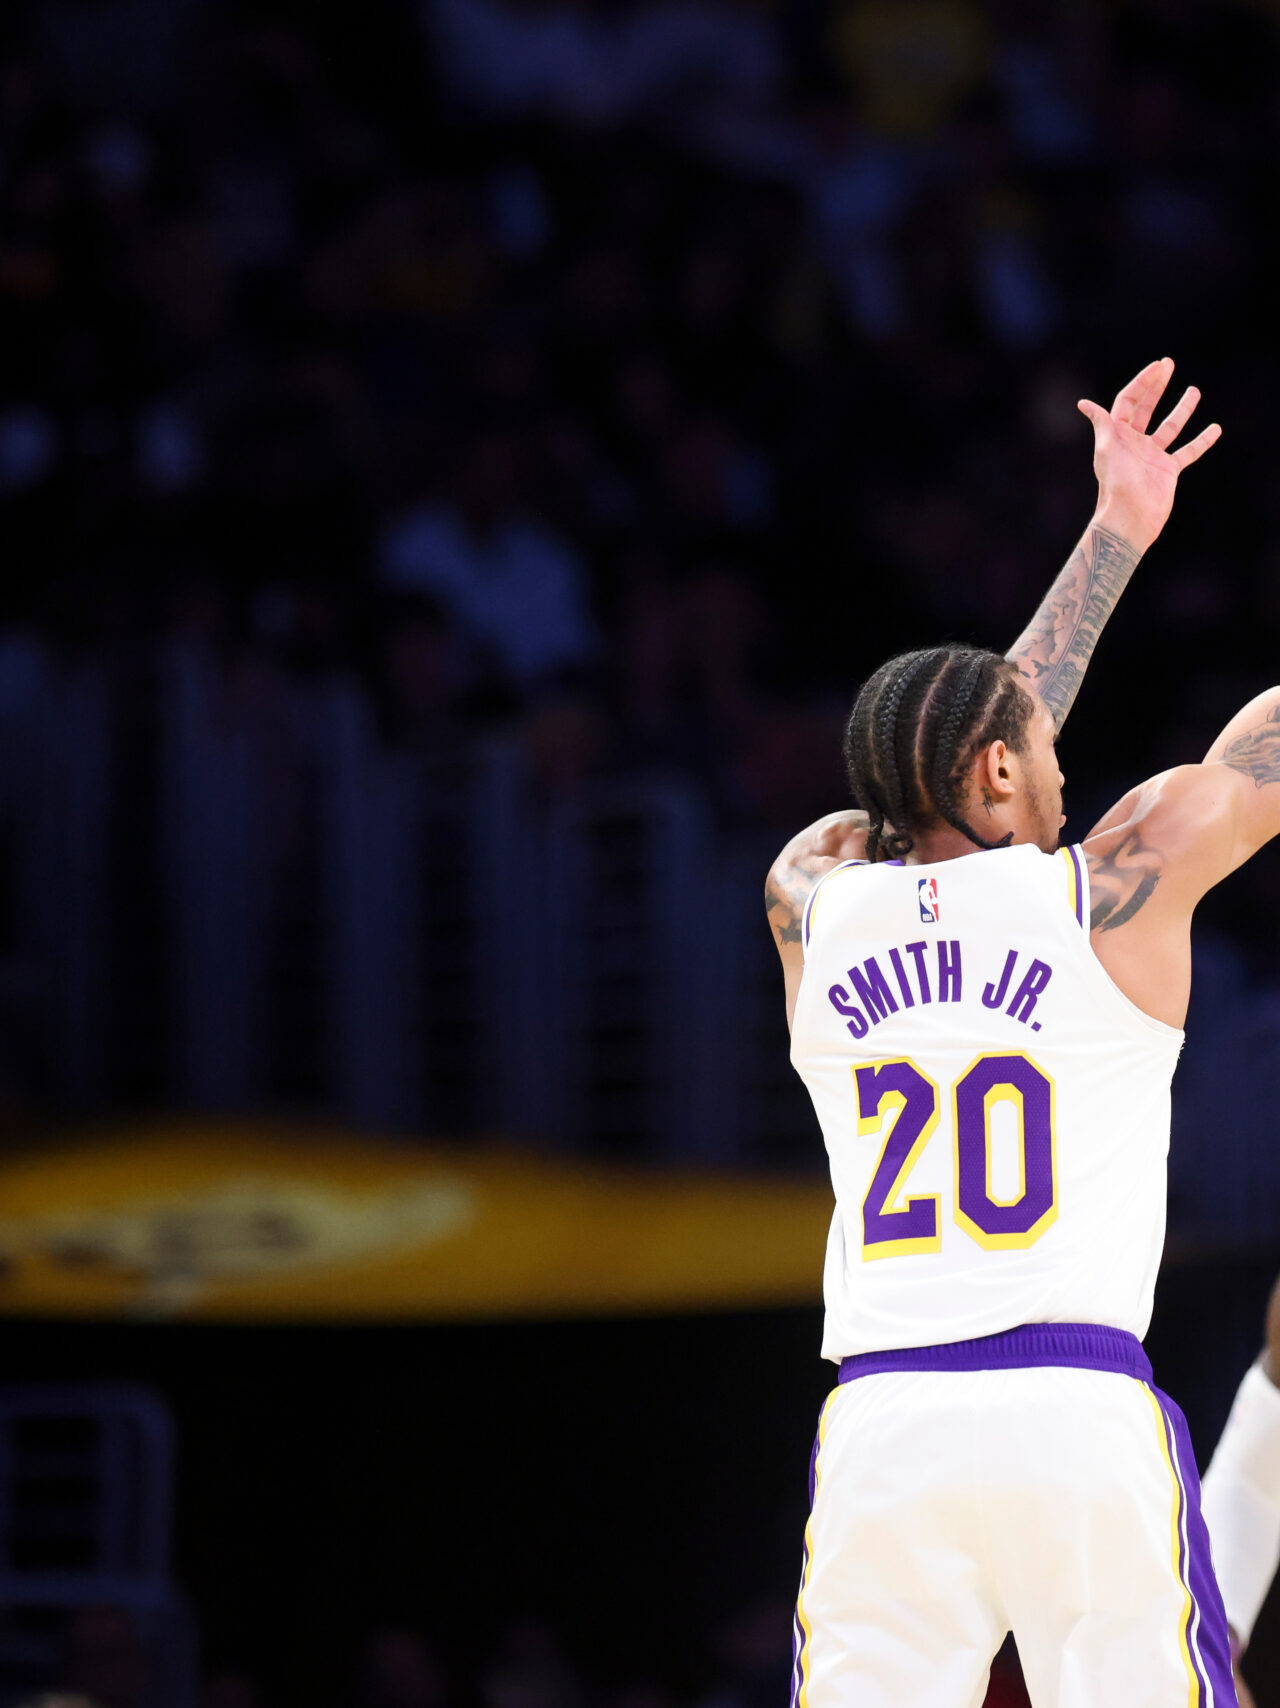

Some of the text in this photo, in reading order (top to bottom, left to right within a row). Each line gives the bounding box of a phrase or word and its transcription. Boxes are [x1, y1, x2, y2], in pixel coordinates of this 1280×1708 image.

[828, 940, 1053, 1040] SMITH JR.
[850, 1050, 1059, 1262] 20
